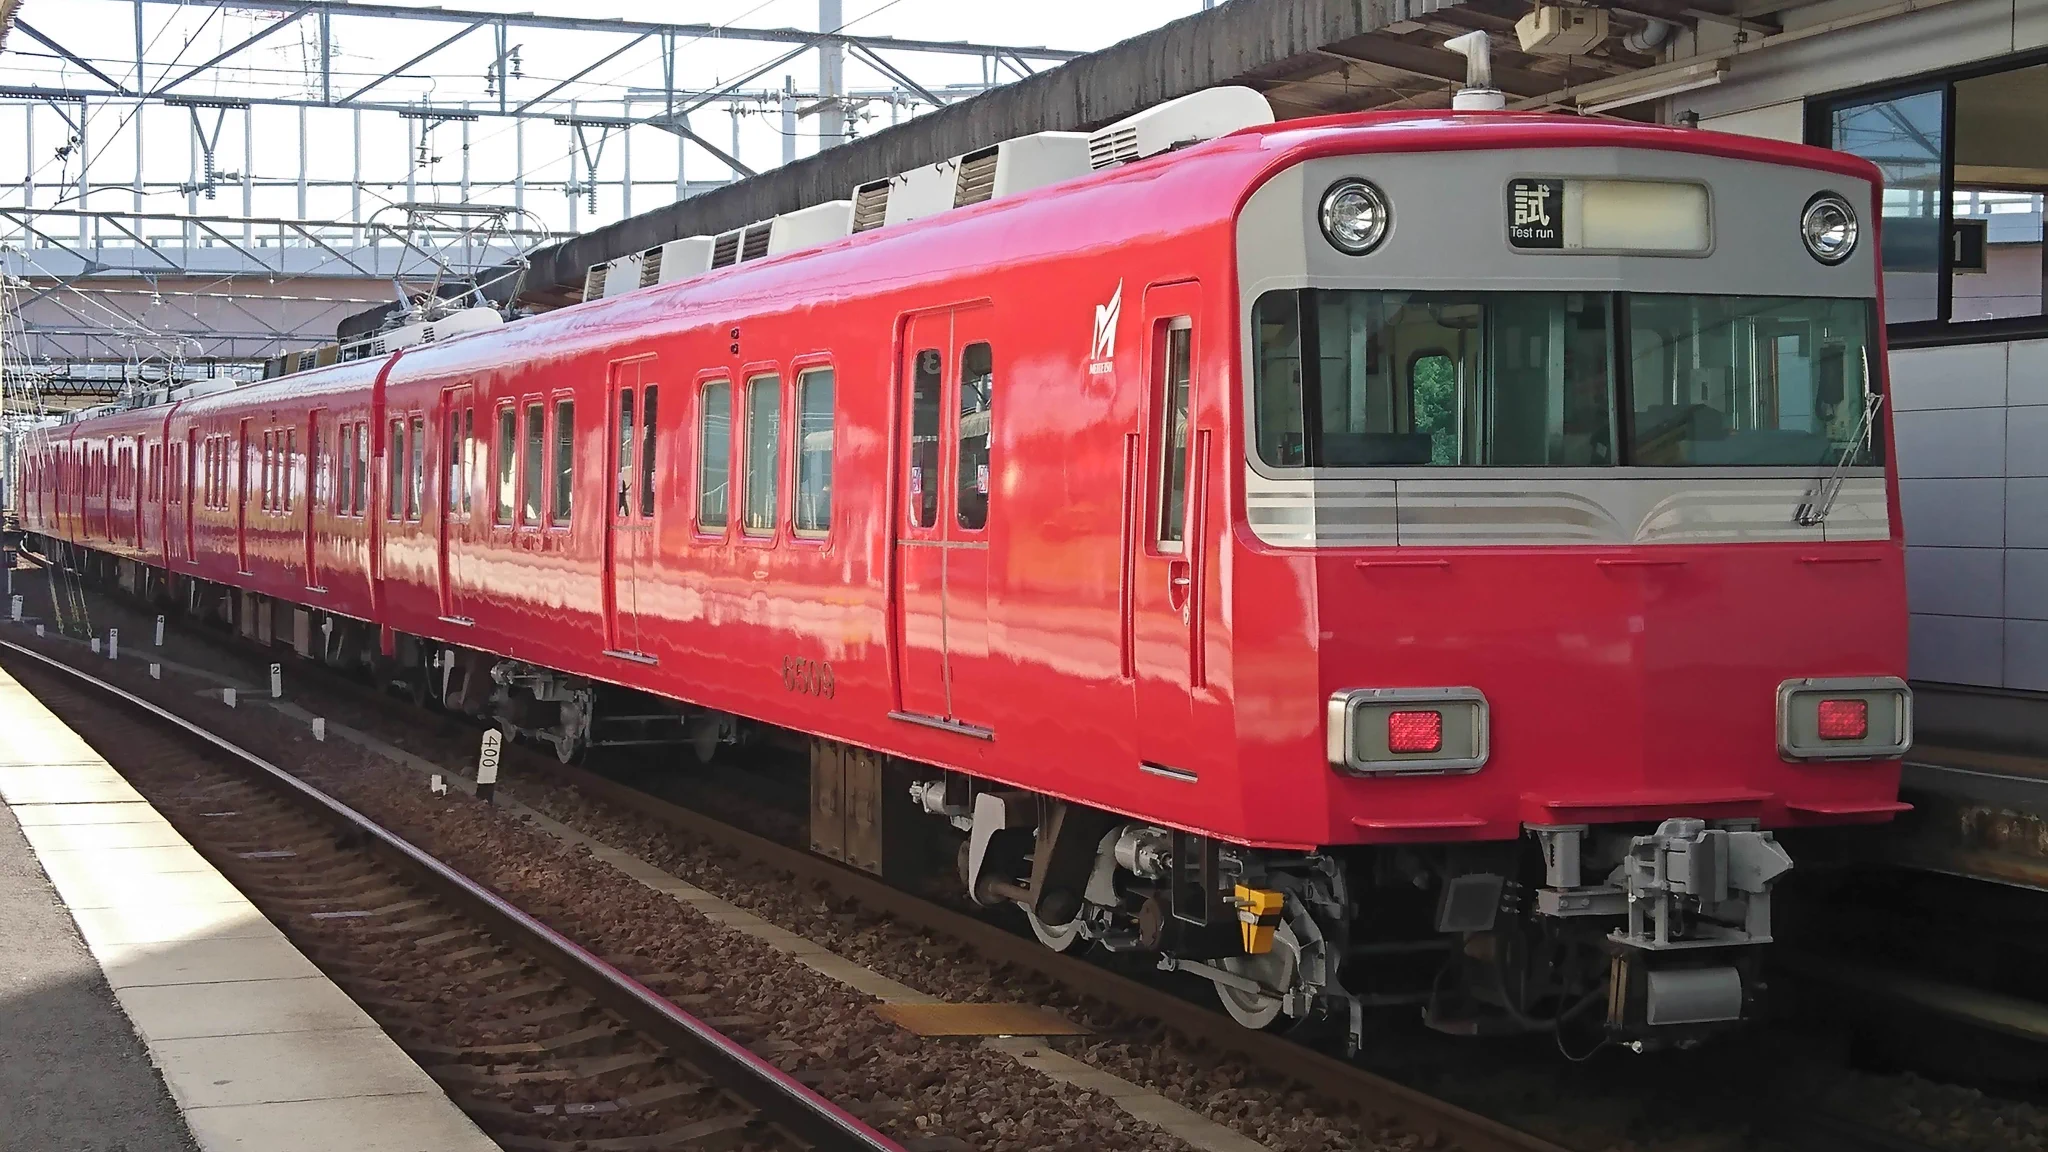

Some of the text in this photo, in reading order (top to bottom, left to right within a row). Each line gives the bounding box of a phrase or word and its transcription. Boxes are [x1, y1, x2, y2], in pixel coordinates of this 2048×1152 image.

[1514, 184, 1550, 227] 試
[1510, 226, 1554, 239] Test run
[157, 616, 164, 624] 4
[111, 630, 117, 638] 2
[272, 666, 280, 675] 2
[782, 654, 835, 700] 6509
[482, 735, 499, 768] 400
